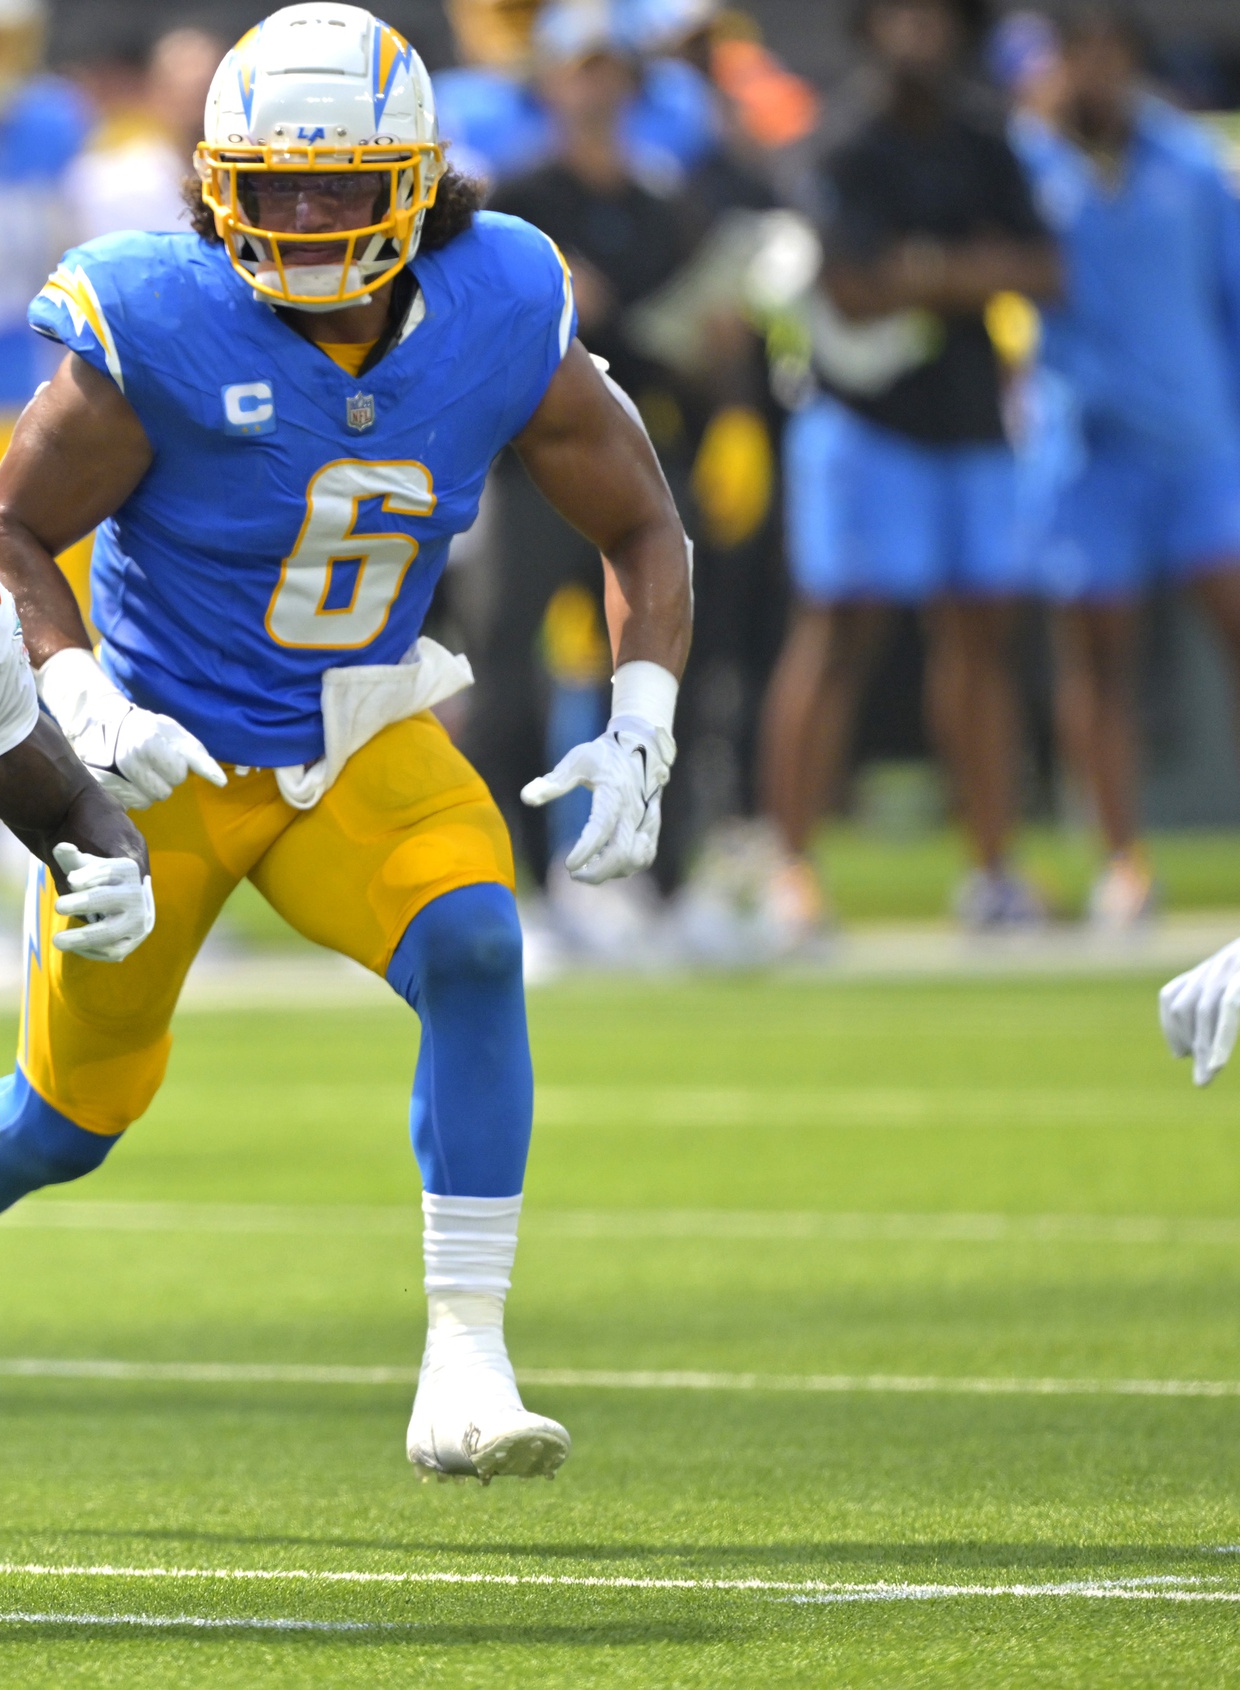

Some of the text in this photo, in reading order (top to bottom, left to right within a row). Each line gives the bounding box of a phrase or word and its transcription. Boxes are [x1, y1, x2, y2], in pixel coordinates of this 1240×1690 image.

[297, 127, 326, 146] LA
[224, 382, 274, 425] C
[264, 458, 437, 649] 6
